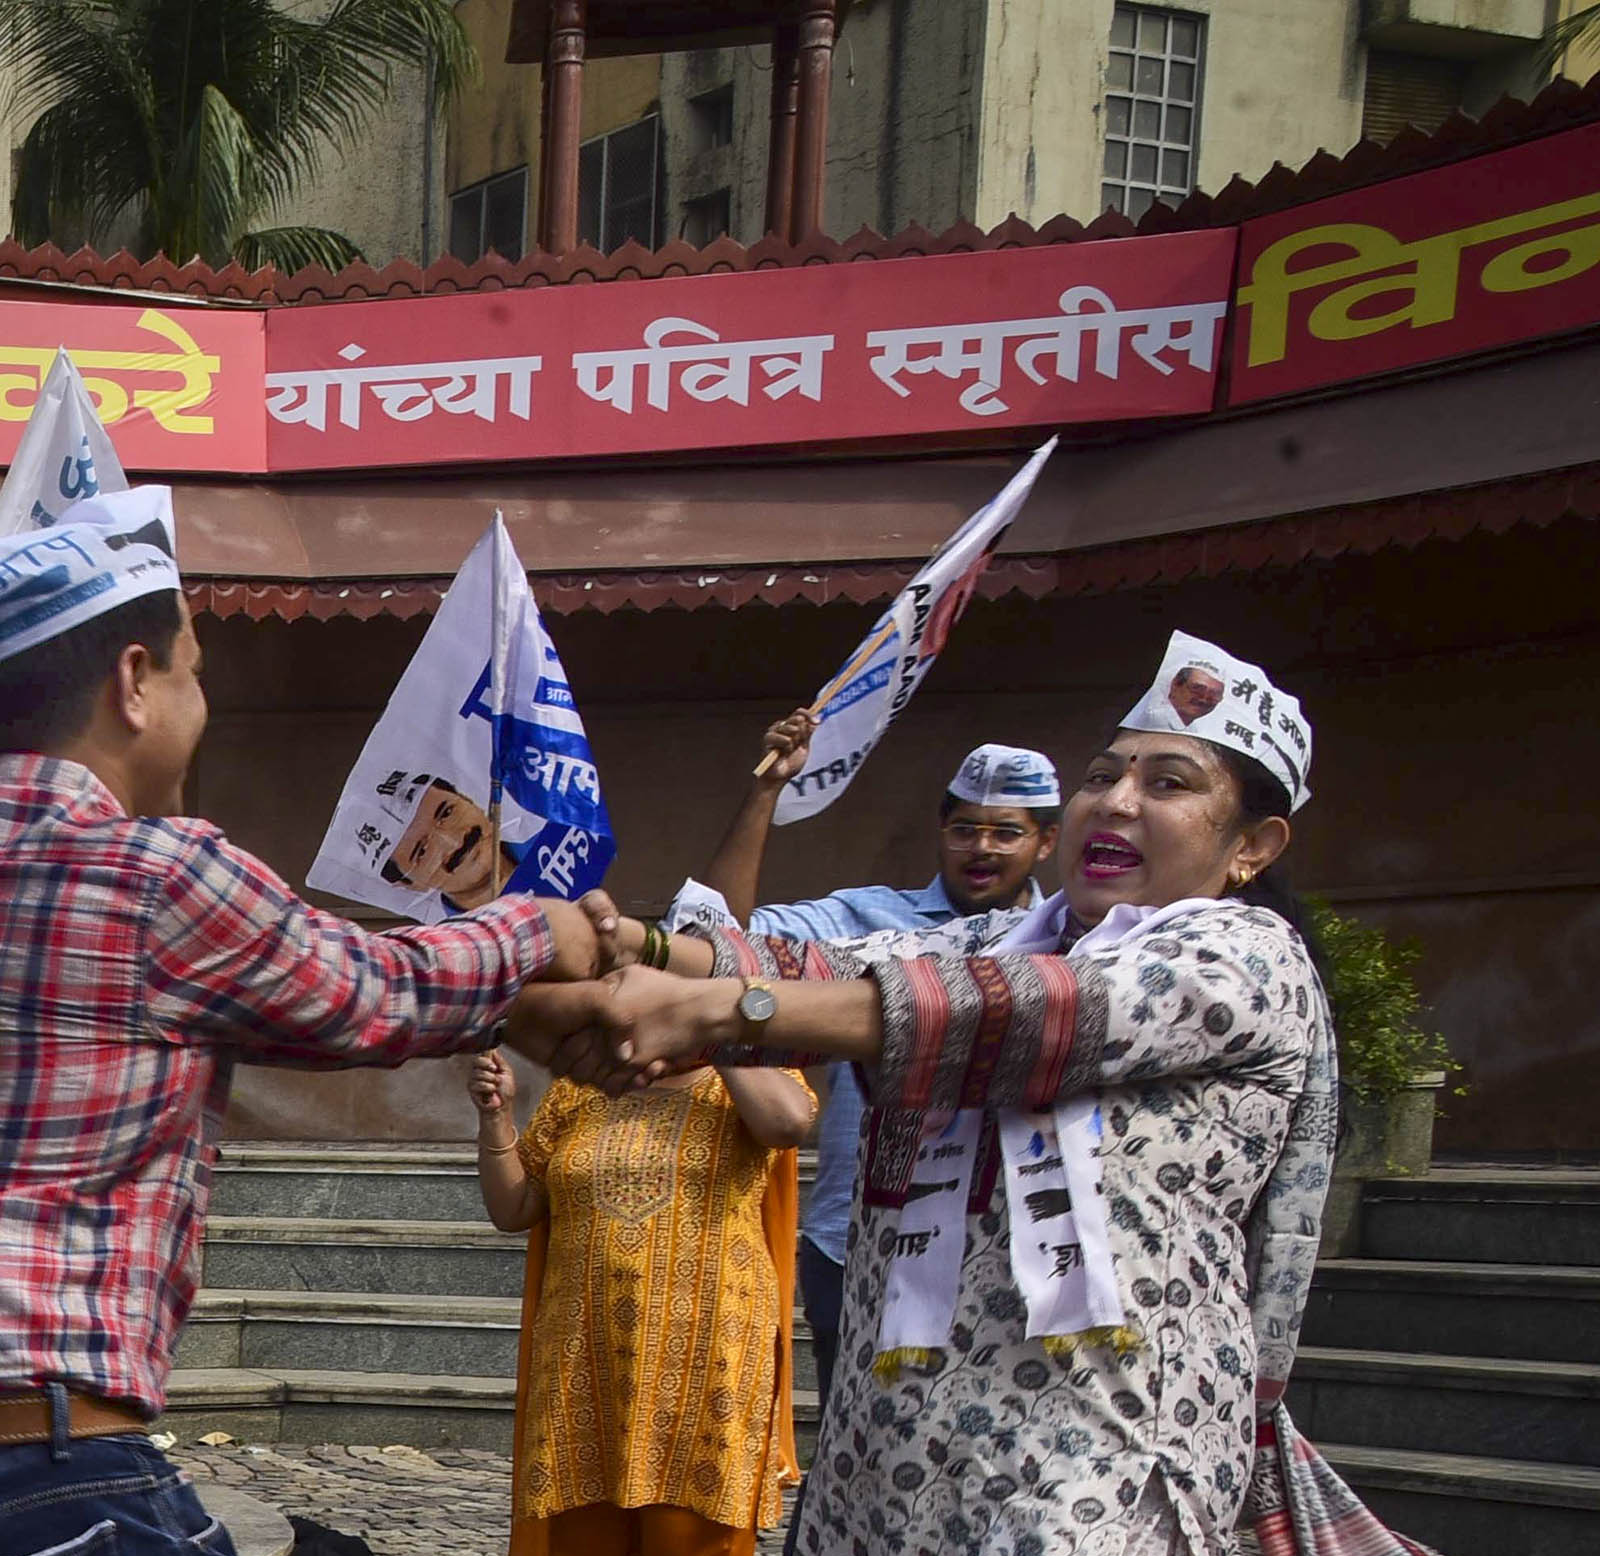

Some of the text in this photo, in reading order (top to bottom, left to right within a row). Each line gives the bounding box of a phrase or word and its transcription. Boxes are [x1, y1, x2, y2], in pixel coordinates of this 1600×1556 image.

[265, 285, 1228, 430] यांच्या पवित्र स्मृतीस
